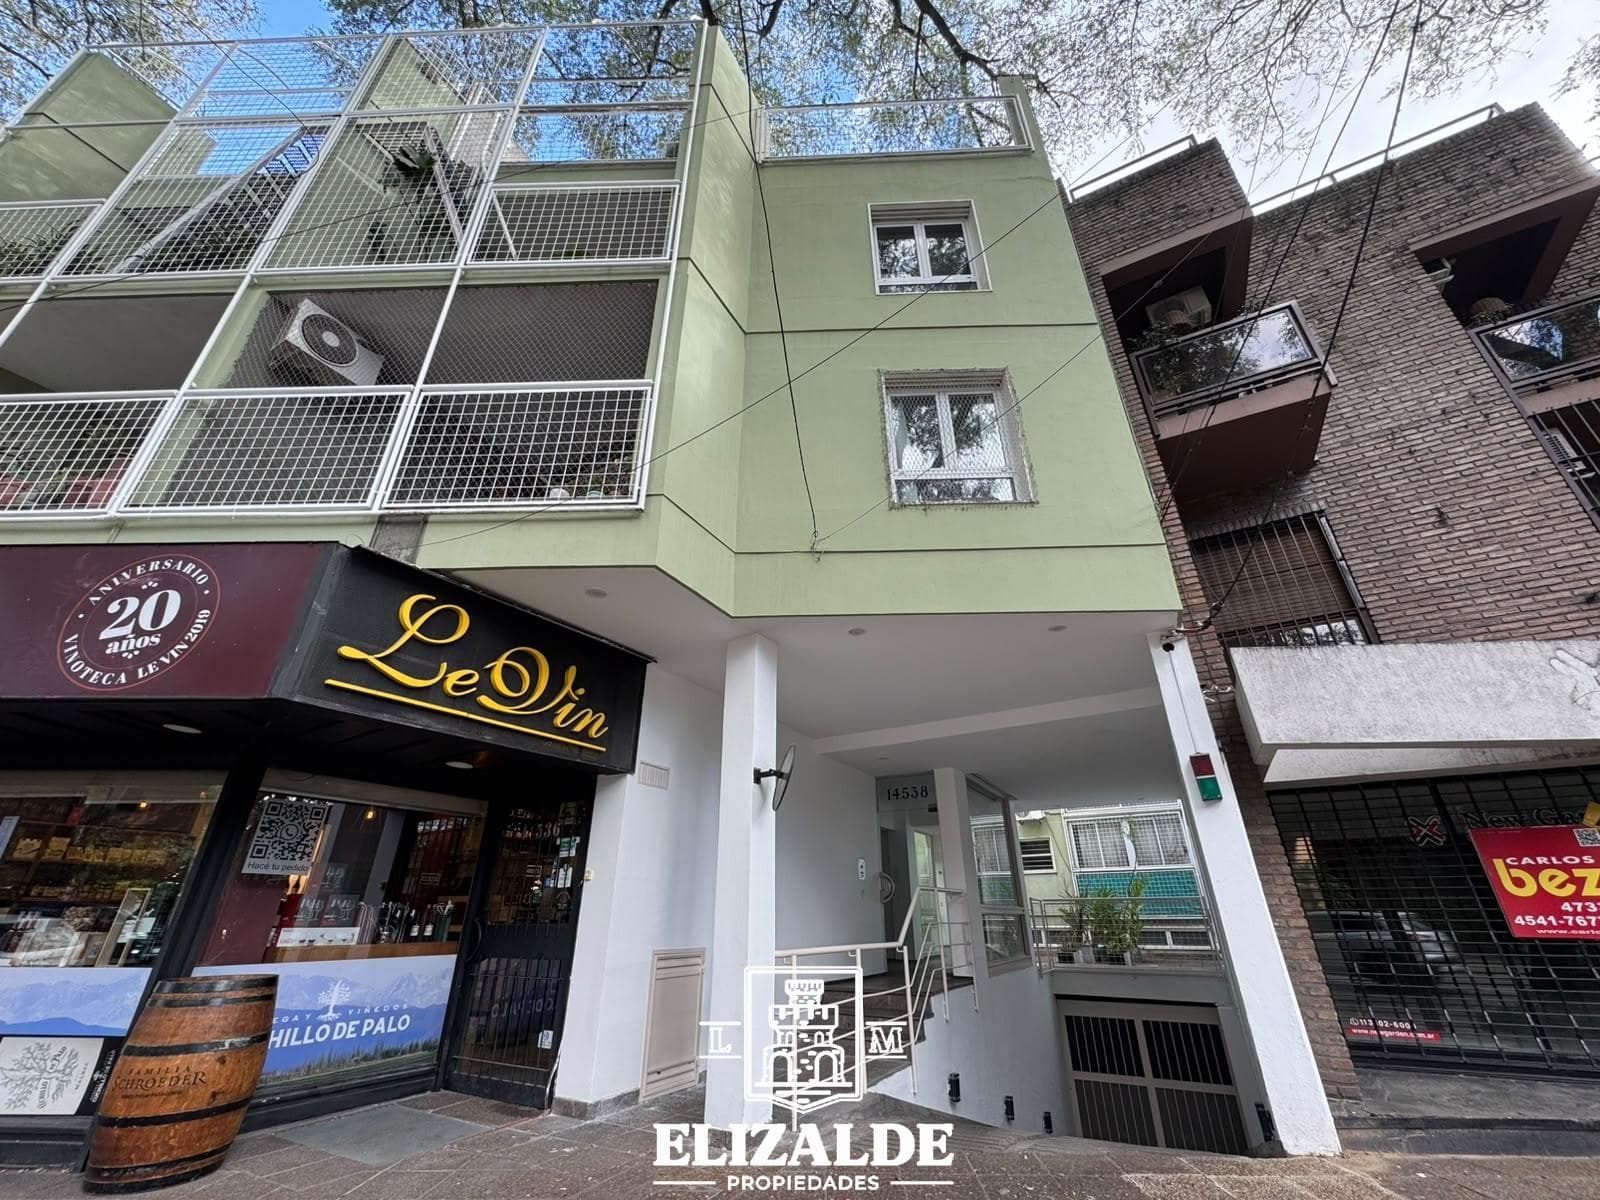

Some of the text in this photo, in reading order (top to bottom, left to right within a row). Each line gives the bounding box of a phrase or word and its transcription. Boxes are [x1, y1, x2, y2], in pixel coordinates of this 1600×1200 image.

[88, 558, 209, 606] ANIVERSARIO
[98, 589, 182, 640] 20
[63, 609, 211, 685] VINOTECA LE VIN 2019
[105, 633, 162, 655] años
[336, 593, 609, 739] Le Vin
[271, 863, 281, 871] tu
[1505, 855, 1596, 866] CARLOS
[1560, 901, 1600, 913] 473
[1514, 915, 1600, 927] 4541-767
[331, 1019, 361, 1041] DE
[360, 1014, 411, 1037] PALO
[112, 1070, 207, 1092] SCHROEDER
[128, 1065, 191, 1076] FAMILIA
